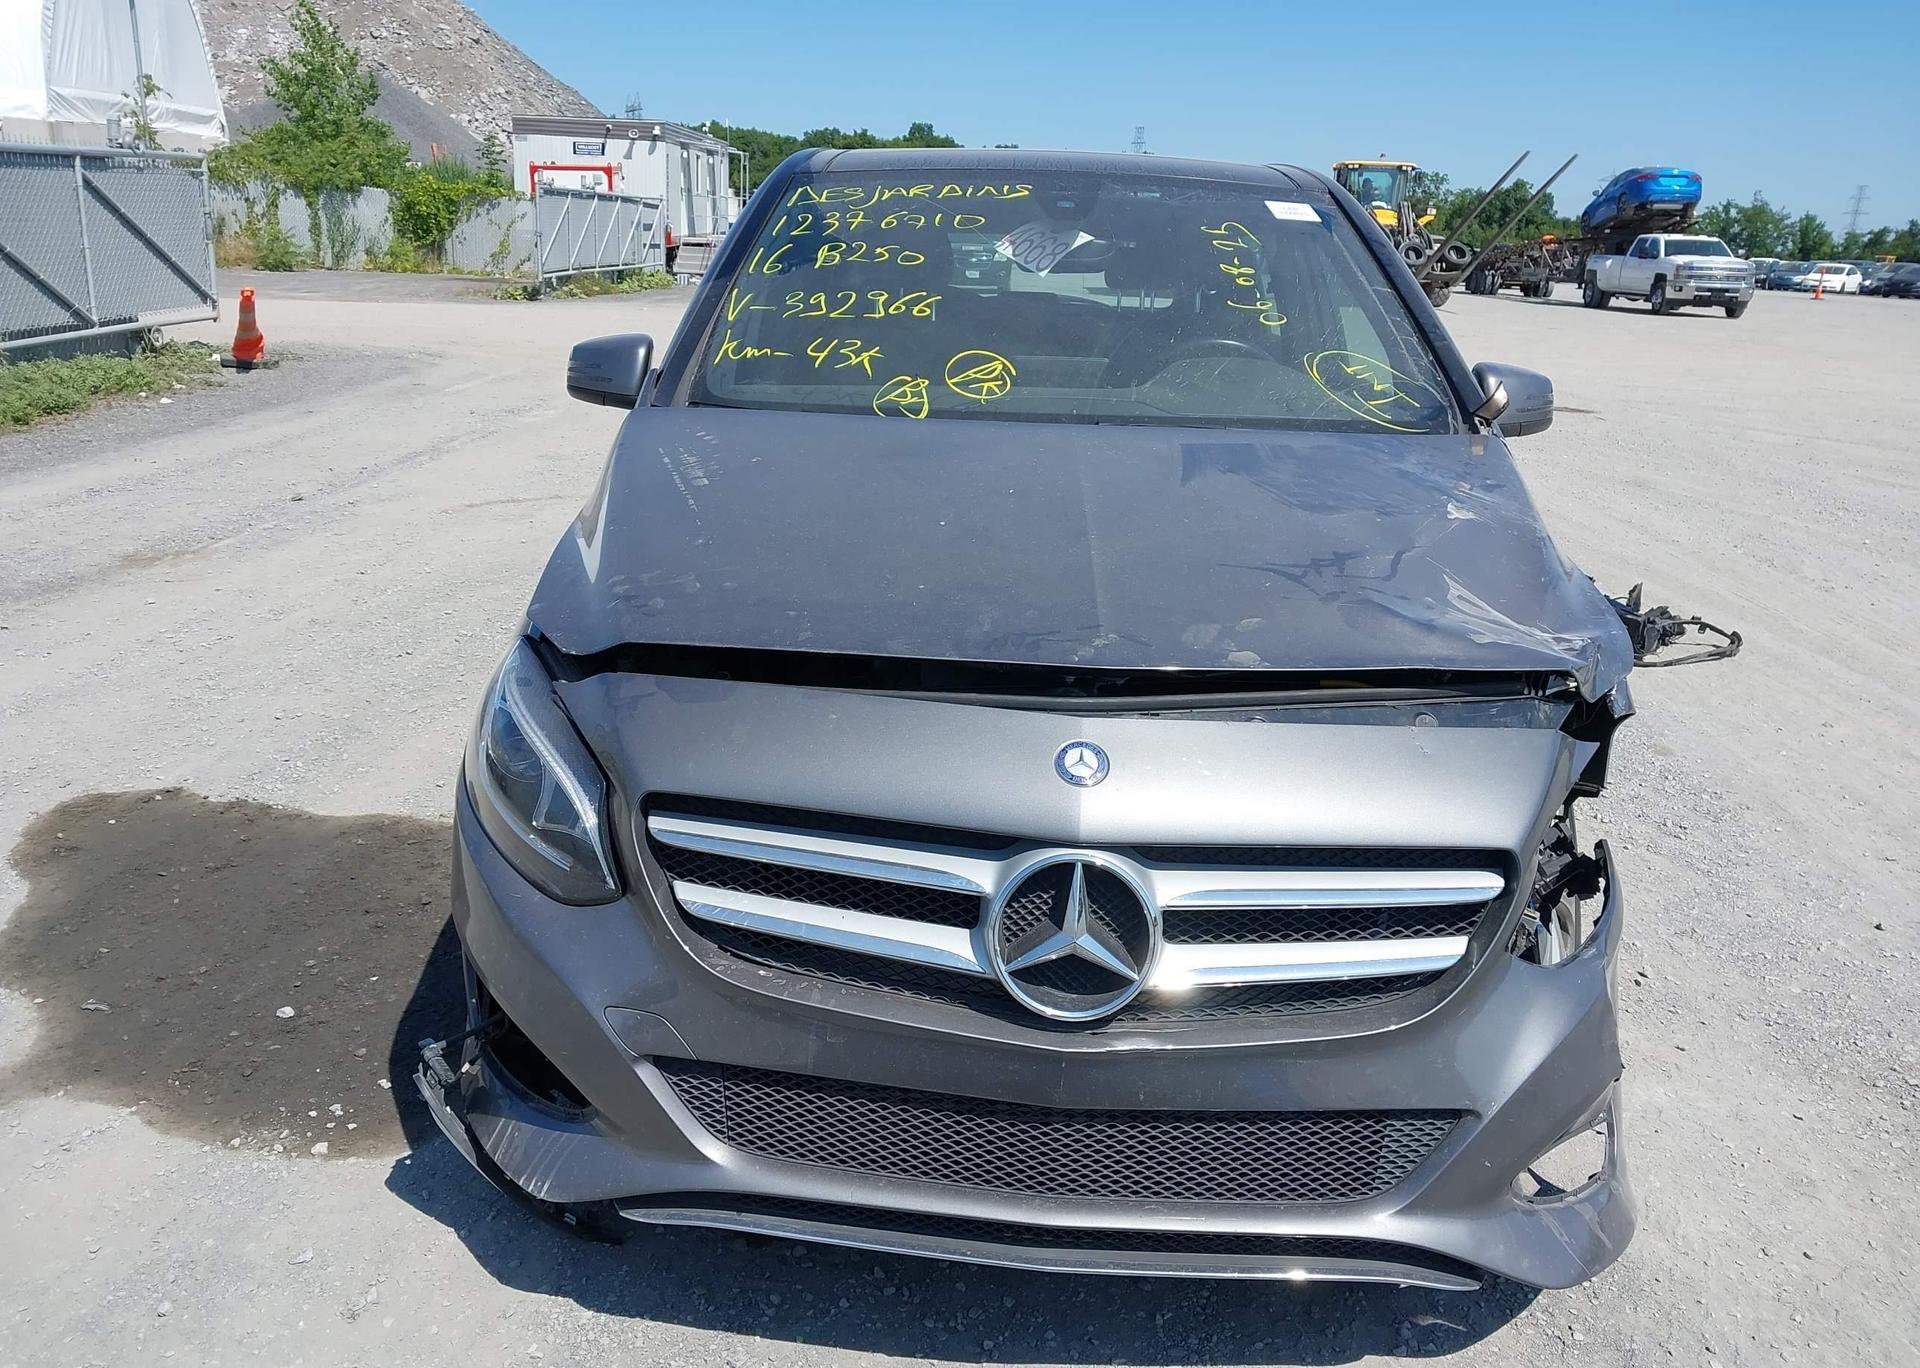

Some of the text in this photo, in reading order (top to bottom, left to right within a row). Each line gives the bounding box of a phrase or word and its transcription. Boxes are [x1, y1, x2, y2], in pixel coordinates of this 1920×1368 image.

[788, 184, 1033, 209] DESJARDINS
[748, 242, 924, 274] 16 B250
